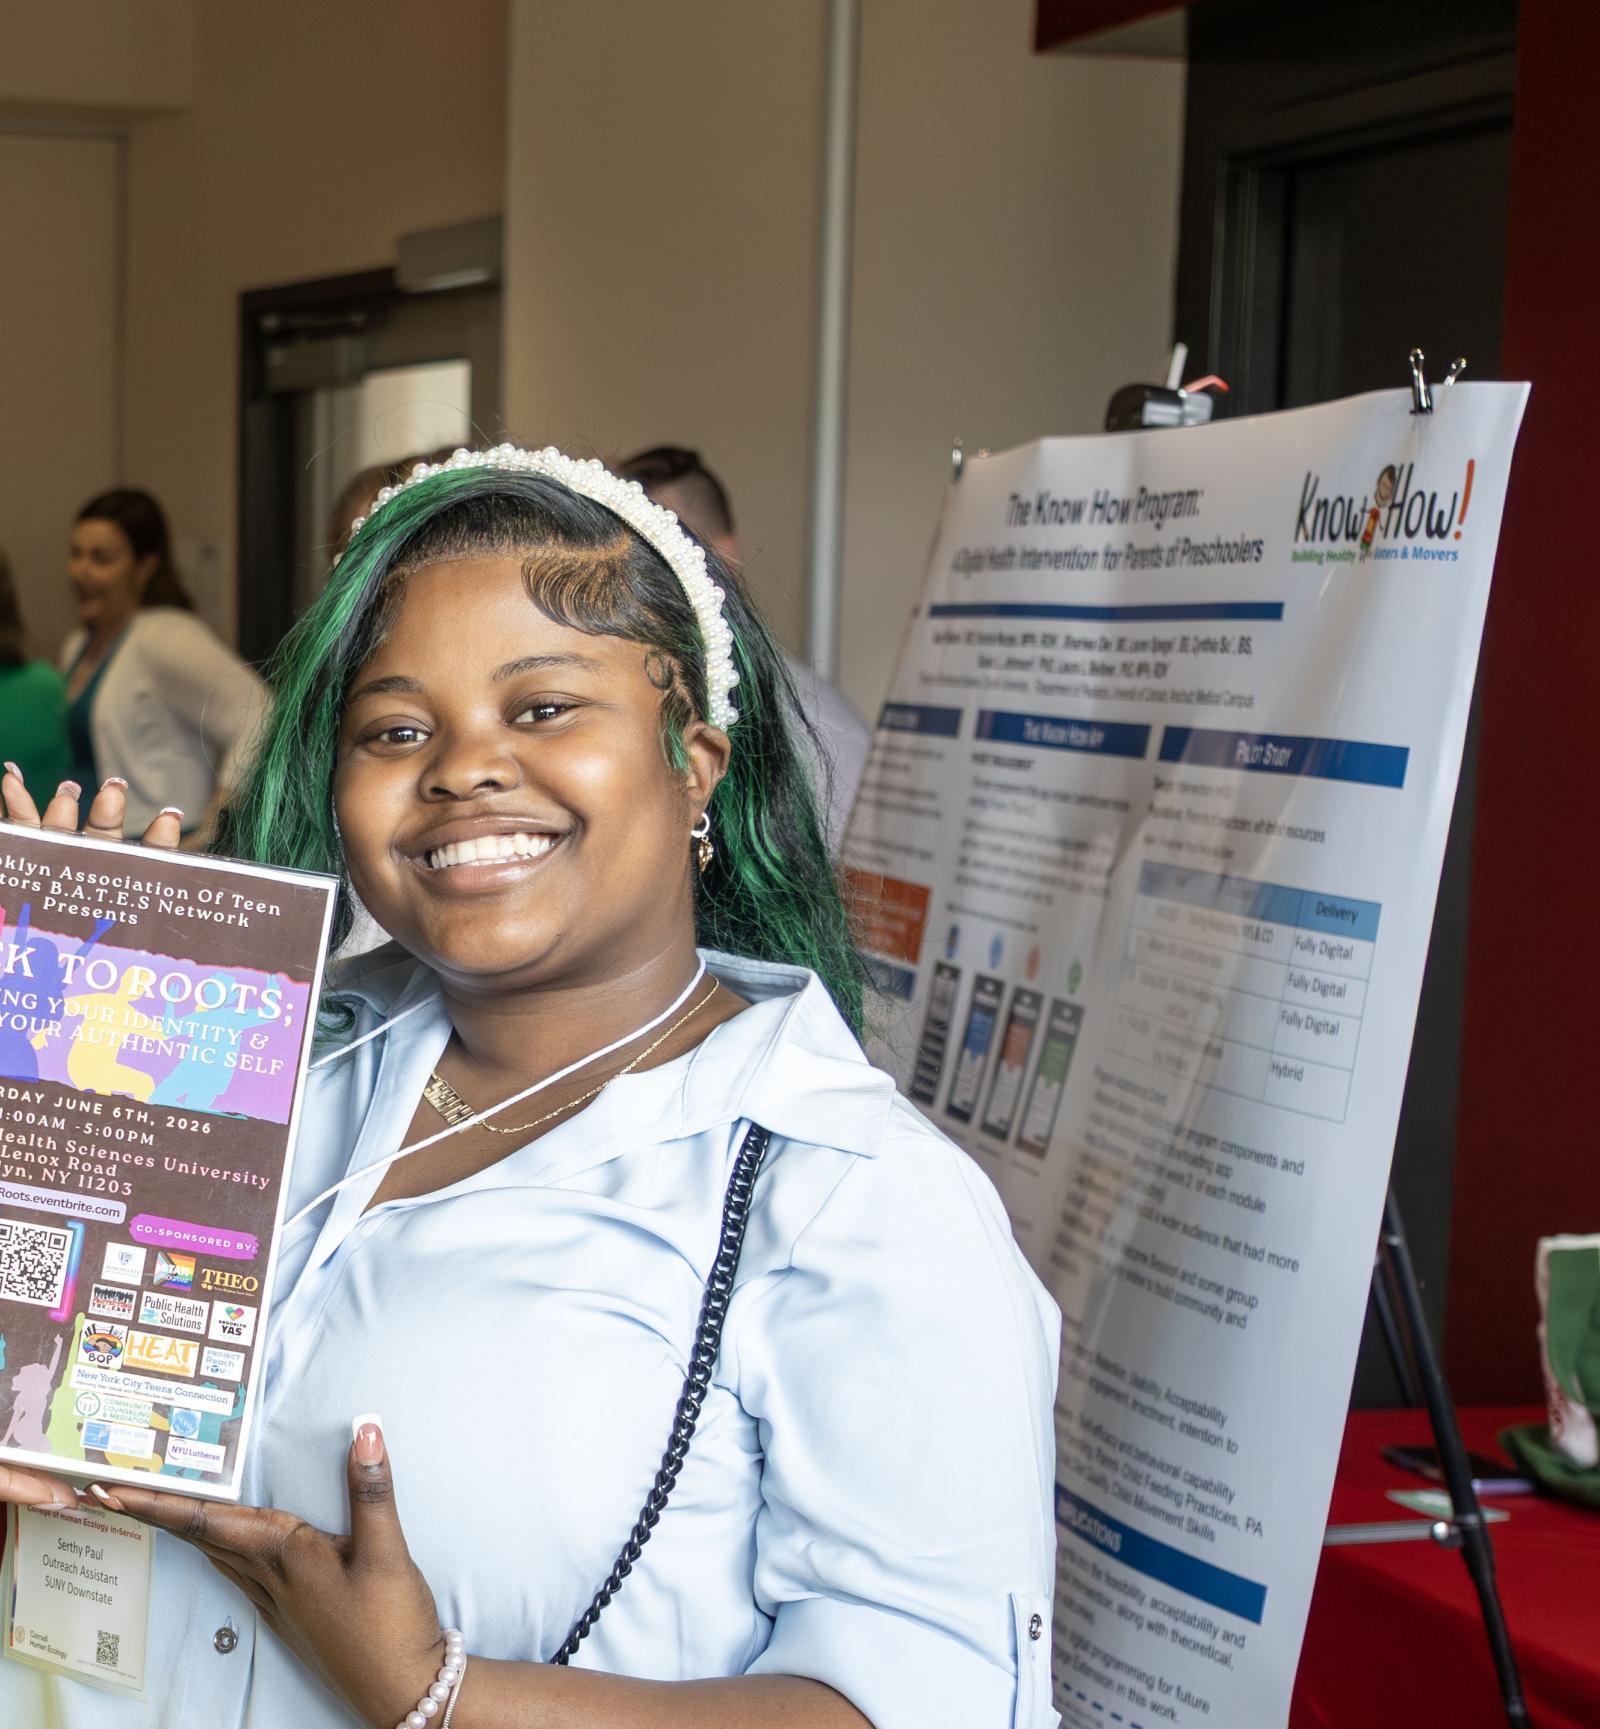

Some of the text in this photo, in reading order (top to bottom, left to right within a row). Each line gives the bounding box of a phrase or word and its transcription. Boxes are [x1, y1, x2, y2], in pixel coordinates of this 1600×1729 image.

[1006, 486, 1204, 530] The Know How Program:
[1294, 459, 1475, 543] Know How!
[1019, 533, 1265, 572] Intervention for Parents of Preschoolers
[1401, 546, 1458, 562] & Movers
[50, 881, 151, 911] B.A.T.E.S
[156, 900, 251, 929] Network
[59, 866, 189, 900] Association
[197, 888, 224, 905] Of
[232, 893, 282, 917] Teen
[42, 896, 138, 926] Presents
[1315, 901, 1358, 925] Delivery
[1295, 936, 1353, 961] Fully Digital
[56, 952, 119, 991] TO
[128, 965, 295, 1028] ROOTS;
[1288, 973, 1346, 998] Fully Digital
[47, 996, 116, 1024] YOUR
[123, 1010, 243, 1046] IDENTITY
[250, 1032, 270, 1050] &
[1281, 1010, 1340, 1036] Fully Digital
[69, 1026, 217, 1065] AUTHENTIC
[224, 1051, 285, 1076] SELF
[1271, 1060, 1304, 1081] Hybrid
[52, 1094, 103, 1116] JUNE
[112, 1101, 156, 1126] 6TH,
[165, 1113, 213, 1135] 2026
[74, 1120, 157, 1147] -5:00PM
[0, 1143, 63, 1166] Lenox
[67, 1155, 118, 1178] Road
[65, 1138, 156, 1169] Sciences
[163, 1157, 272, 1190] University
[1220, 1140, 1278, 1169] components
[1281, 1158, 1304, 1176] and
[40, 1170, 72, 1185] NY
[77, 1174, 134, 1197] 11203
[1229, 1191, 1266, 1214] module
[136, 1224, 256, 1253] CO-SPONSORED BY:
[1222, 1235, 1299, 1273] that had more
[202, 1268, 258, 1291] THEO
[145, 1296, 204, 1317] Public Health
[1198, 1276, 1224, 1296] some
[1227, 1287, 1258, 1312] group
[160, 1312, 202, 1330] Solutions
[222, 1325, 242, 1336] YAS
[1225, 1311, 1248, 1329] and
[88, 1353, 113, 1364] BOP
[127, 1334, 198, 1364] HEAT
[207, 1350, 240, 1360] PROJECT
[207, 1356, 234, 1367] Reach
[77, 1370, 98, 1379] New
[100, 1373, 120, 1384] York
[123, 1378, 143, 1390] City
[144, 1382, 172, 1394] Teens
[174, 1388, 228, 1405] Connection
[103, 1405, 150, 1418] COUNSELING
[104, 1398, 151, 1411] COMMUNITY
[1164, 1388, 1228, 1429] Acceptability
[110, 1413, 149, 1424] MEDIATION
[172, 1446, 220, 1460] NYU Lutheran
[1226, 1437, 1238, 1454] to
[1183, 1468, 1235, 1505] capability
[1185, 1493, 1264, 1538] Practices, PA
[83, 1518, 109, 1533] Ecology
[110, 1525, 142, 1541] In-Service
[1185, 1516, 1216, 1543] Skills
[58, 1538, 104, 1561] Serthy Paul
[42, 1554, 118, 1586] Outreach Assistant
[44, 1575, 113, 1606] SUNY Downstate
[30, 1630, 48, 1642] Cornell
[1147, 1619, 1169, 1637] with
[1151, 1596, 1246, 1649] acceptability and
[29, 1641, 67, 1660] Human Ecology
[1158, 1676, 1210, 1714] for future
